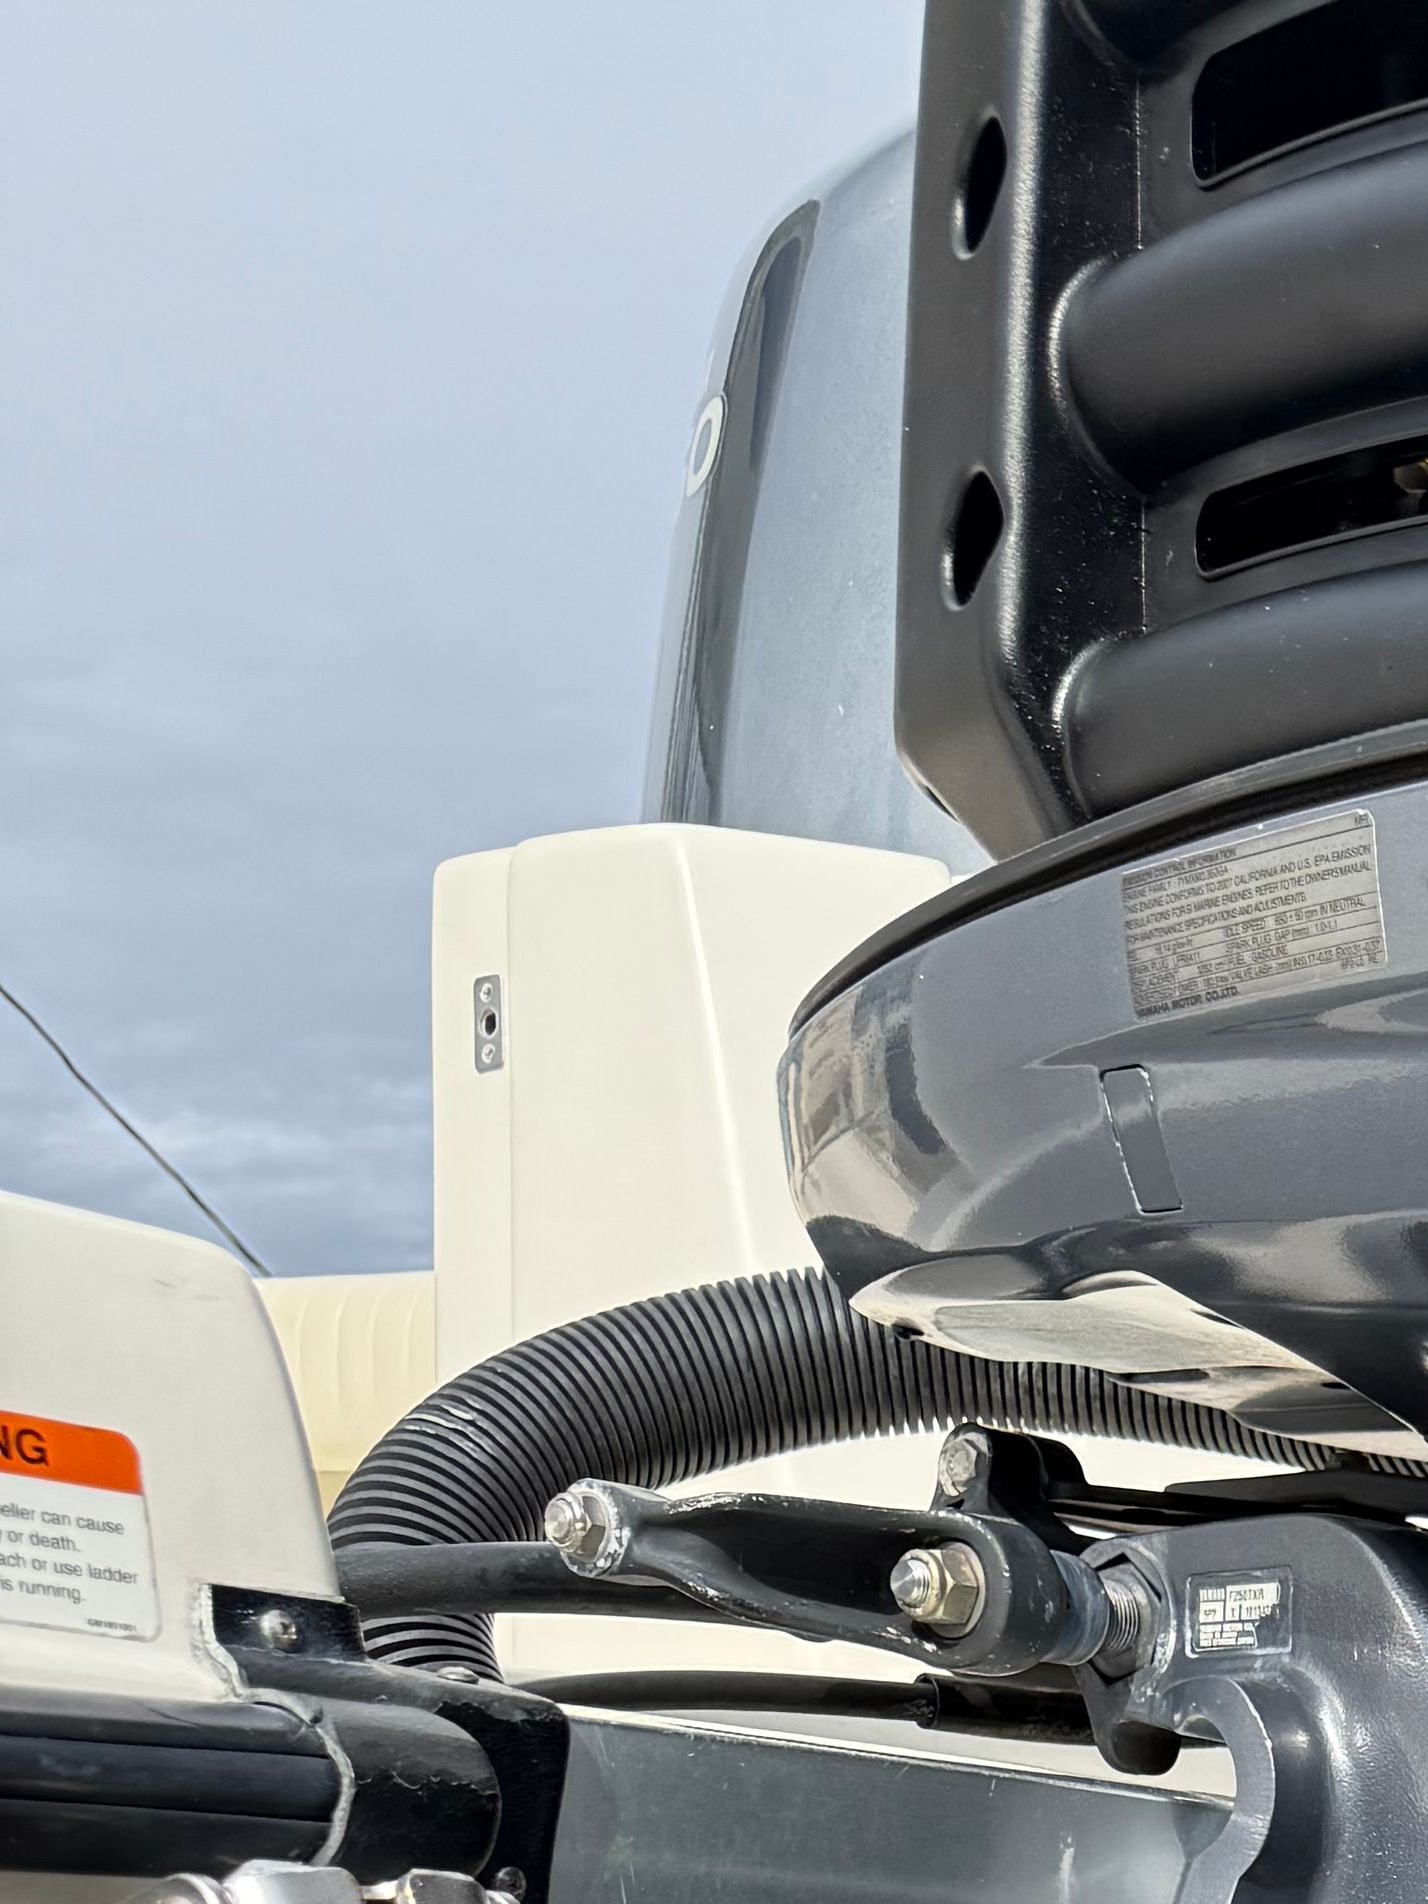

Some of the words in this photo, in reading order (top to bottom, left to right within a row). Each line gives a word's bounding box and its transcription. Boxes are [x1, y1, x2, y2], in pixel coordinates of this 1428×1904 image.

[1278, 861, 1295, 875] AND
[40, 1510, 72, 1526] can
[75, 1516, 125, 1535] cause
[7, 1530, 25, 1544] or
[28, 1531, 82, 1553] death.
[31, 1558, 49, 1572] or
[53, 1561, 83, 1577] use
[87, 1563, 140, 1585] ladder
[18, 1580, 88, 1605] running.
